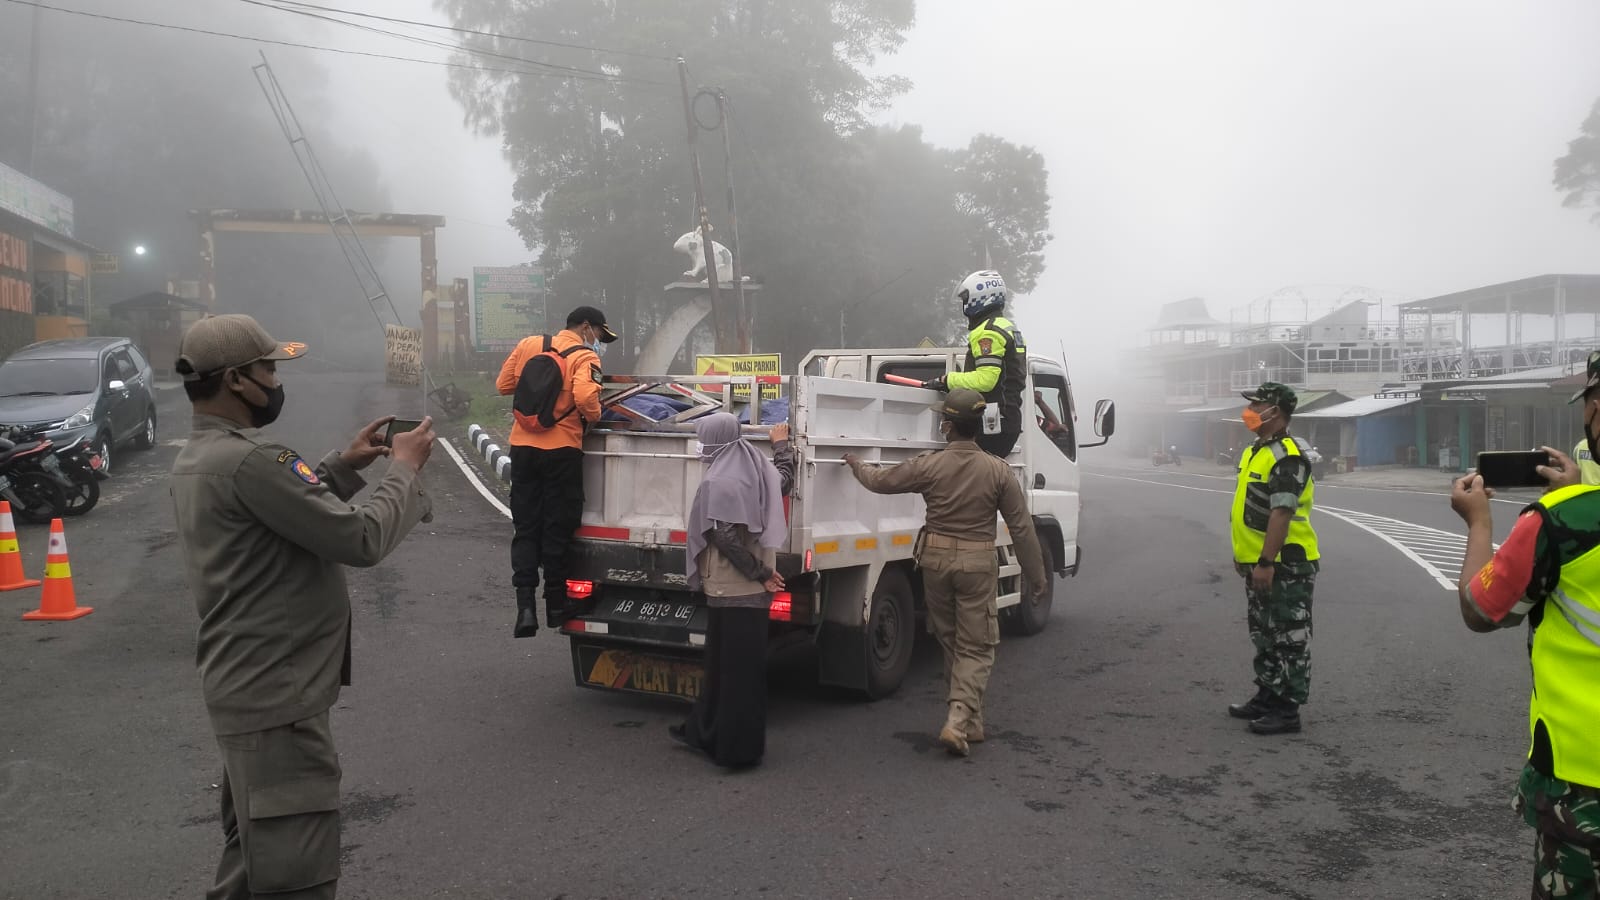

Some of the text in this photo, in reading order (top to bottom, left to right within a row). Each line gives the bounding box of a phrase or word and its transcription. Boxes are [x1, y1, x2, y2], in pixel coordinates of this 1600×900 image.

[385, 327, 421, 341] JANGAN
[732, 360, 776, 372] LOKASI PARKIR
[616, 600, 634, 613] AB
[675, 605, 692, 619] UE
